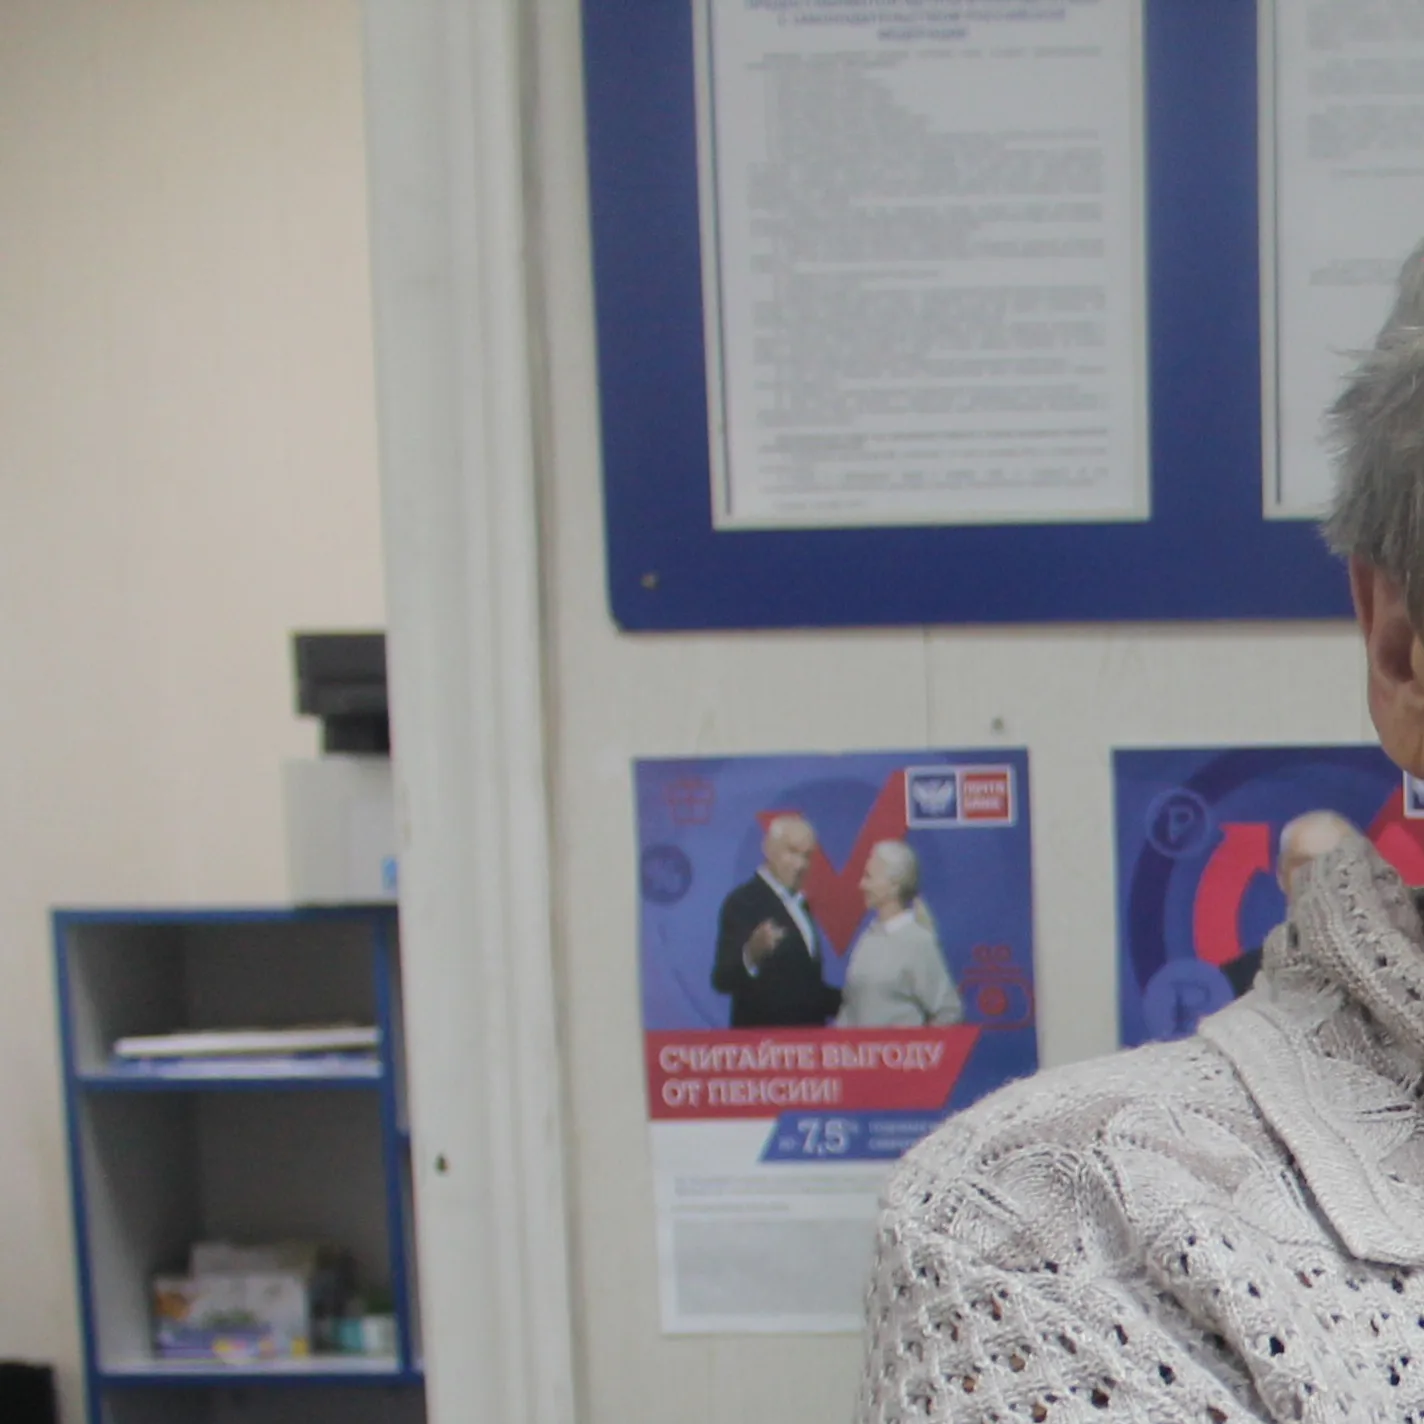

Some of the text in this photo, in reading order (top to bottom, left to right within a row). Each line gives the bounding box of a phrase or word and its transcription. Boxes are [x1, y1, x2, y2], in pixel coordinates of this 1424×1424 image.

[659, 1039, 945, 1073] СЧИТАЙТЕ ВЫГОДУ
[661, 1077, 843, 1106] ОТ ПЕНСИИ!
